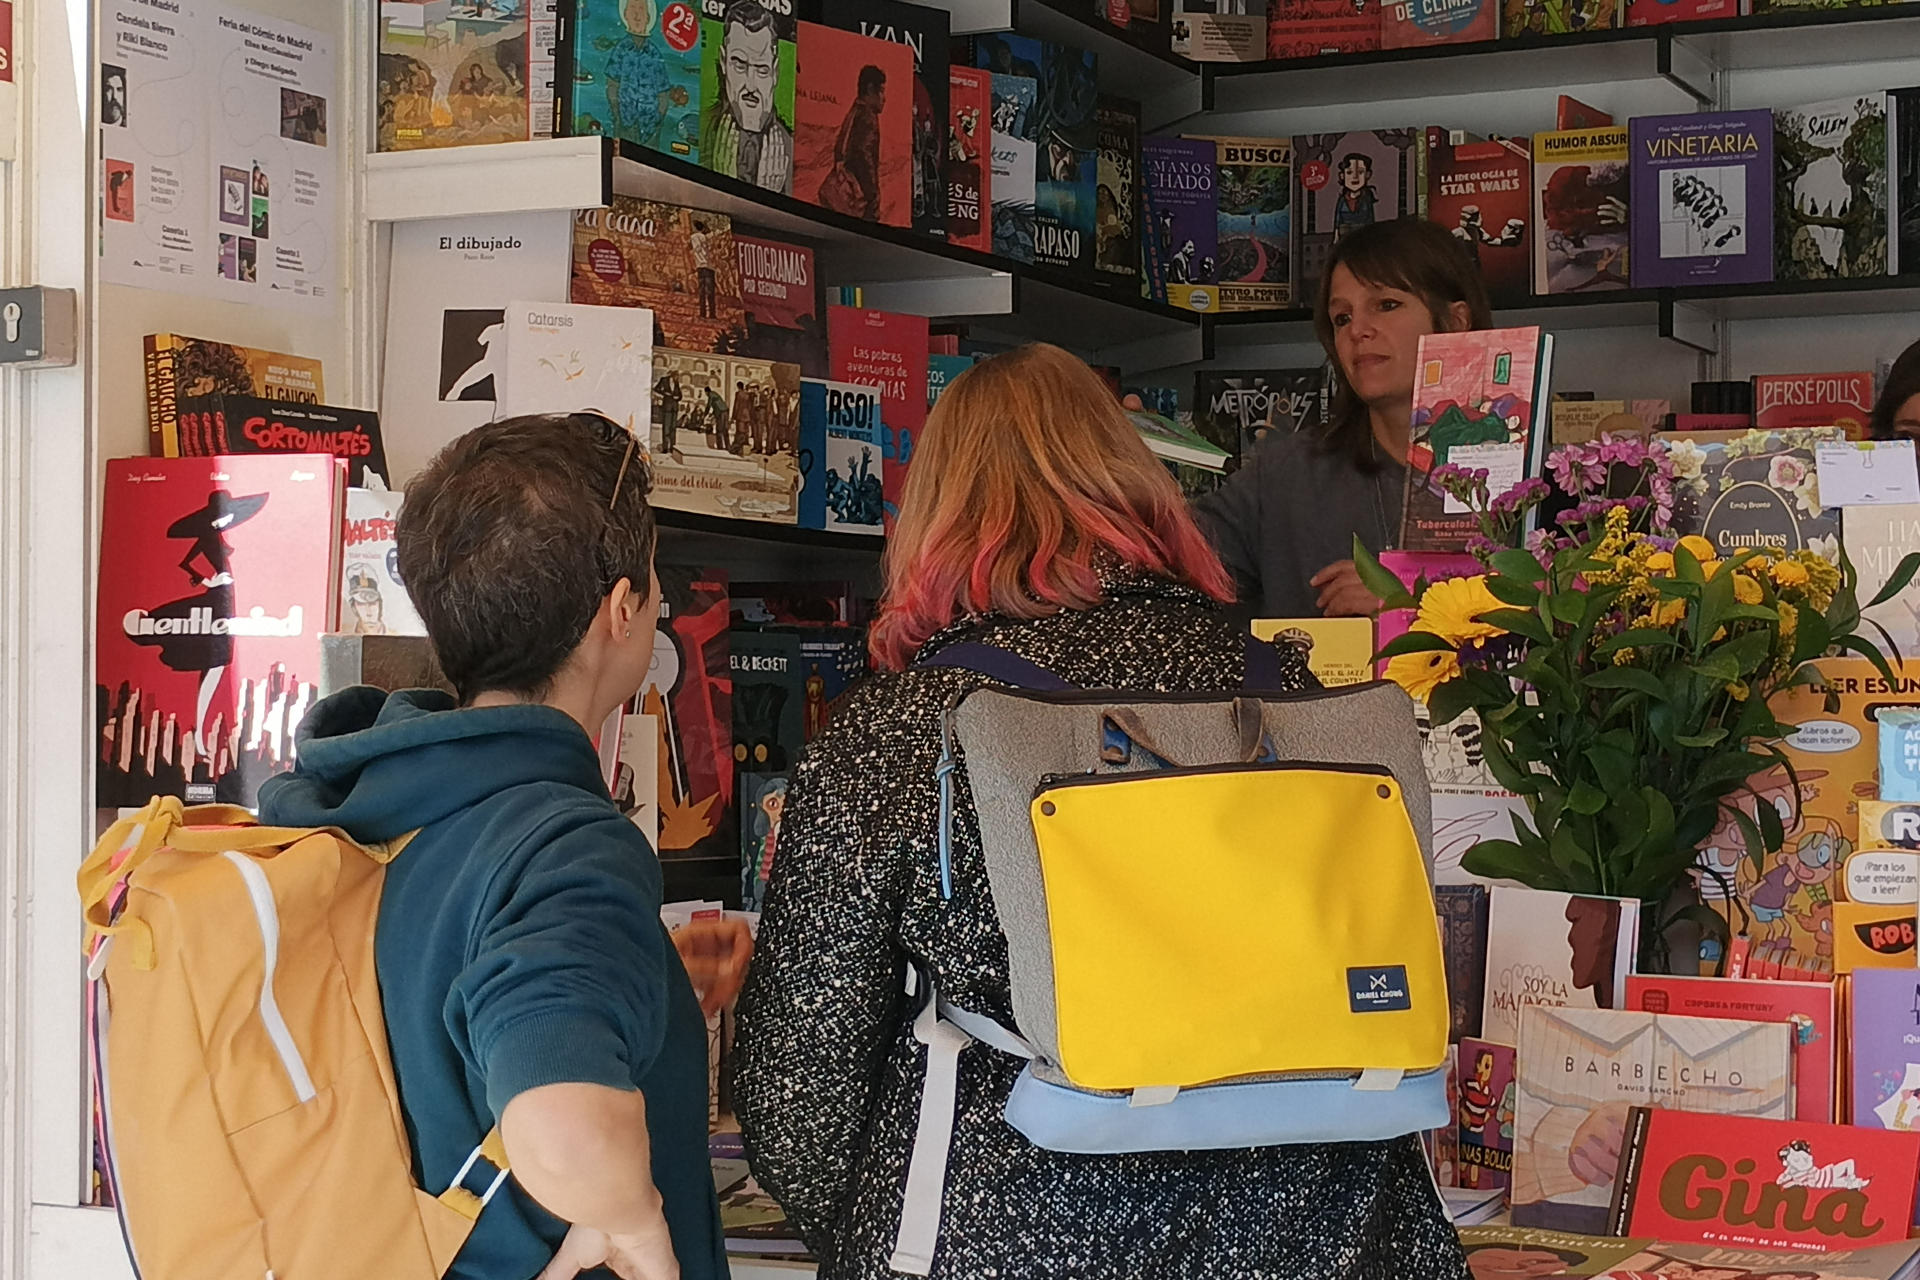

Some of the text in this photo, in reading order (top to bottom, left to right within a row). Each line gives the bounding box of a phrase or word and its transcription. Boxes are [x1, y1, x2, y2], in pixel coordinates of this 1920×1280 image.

[1395, 2, 1416, 21] DE
[218, 16, 238, 30] Feria
[239, 23, 251, 34] del
[276, 33, 286, 43] de
[287, 35, 313, 51] Madrid
[1807, 116, 1849, 139] SALEM
[1544, 133, 1627, 150] HUMOR ABSUR
[1646, 132, 1759, 158] VIÑETARIA
[1441, 175, 1452, 183] LA
[1507, 169, 1518, 178] DE
[965, 189, 979, 201] de
[1441, 178, 1520, 196] STAR WARS
[605, 211, 658, 238] casa
[440, 236, 522, 252] El dibujado
[738, 242, 807, 286] FOTOGRAMAS
[758, 281, 787, 299] SEGUNDO
[528, 312, 574, 328] Catarsis
[853, 346, 903, 363] Las pobres
[146, 353, 158, 398] VERANO
[847, 362, 909, 378] aventuras de
[1763, 376, 1861, 411] PERSÉPOLIS
[149, 401, 160, 432] INDIO
[825, 387, 875, 430] RSO!
[1729, 501, 1748, 511] Emily
[1416, 520, 1479, 529] Tuberculosi
[1718, 528, 1788, 548] Cumbres
[751, 656, 788, 672] BECKETT
[1865, 678, 1889, 694] ES
[1891, 862, 1906, 872] los
[1854, 873, 1917, 884] que empiezan
[1871, 886, 1878, 895] a
[1523, 975, 1568, 998] SOY LA
[1565, 1056, 1743, 1087] BARBECHO
[1617, 1083, 1687, 1096] DAVID SANCHO
[1659, 1154, 1886, 1239] Gina
